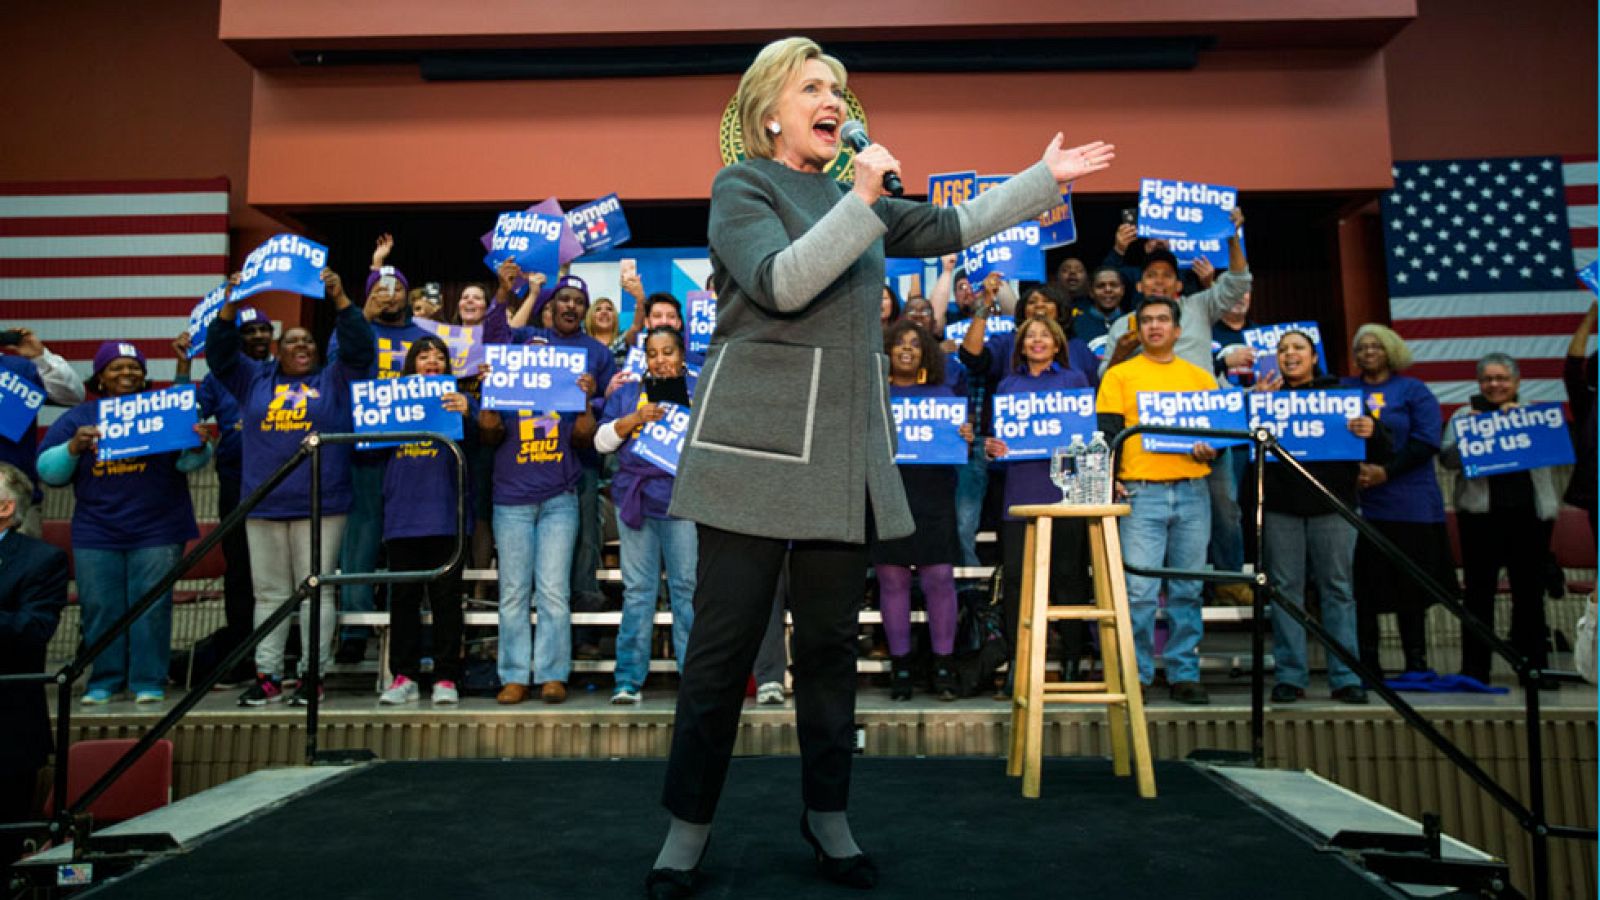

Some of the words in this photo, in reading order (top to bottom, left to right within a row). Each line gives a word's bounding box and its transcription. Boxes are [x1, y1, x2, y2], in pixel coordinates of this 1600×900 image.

[932, 178, 973, 208] AFGE
[1142, 180, 1235, 211] Fighting
[1140, 199, 1173, 219] for
[1176, 206, 1203, 222] us
[497, 211, 562, 241] Fighting
[509, 236, 529, 250] us
[986, 246, 1011, 263] us
[1169, 238, 1196, 252] for
[1199, 239, 1221, 252] us
[263, 256, 292, 272] us
[485, 345, 585, 374] Fighting
[485, 371, 519, 388] for
[523, 372, 552, 388] us
[99, 389, 194, 421] Fighting
[994, 391, 1093, 419] Fighting
[1139, 391, 1242, 416] Fighting
[1250, 391, 1361, 419] Fighting
[353, 404, 391, 427] for
[395, 404, 425, 423] us
[1455, 407, 1563, 438] Fighting
[97, 420, 135, 440] for
[137, 416, 163, 434] us
[904, 423, 934, 442] us
[994, 418, 1030, 437] for
[1032, 418, 1062, 436] us
[1293, 419, 1324, 437] us
[521, 439, 558, 455] SEIU
[1458, 437, 1495, 457] for
[1500, 433, 1531, 451] us
